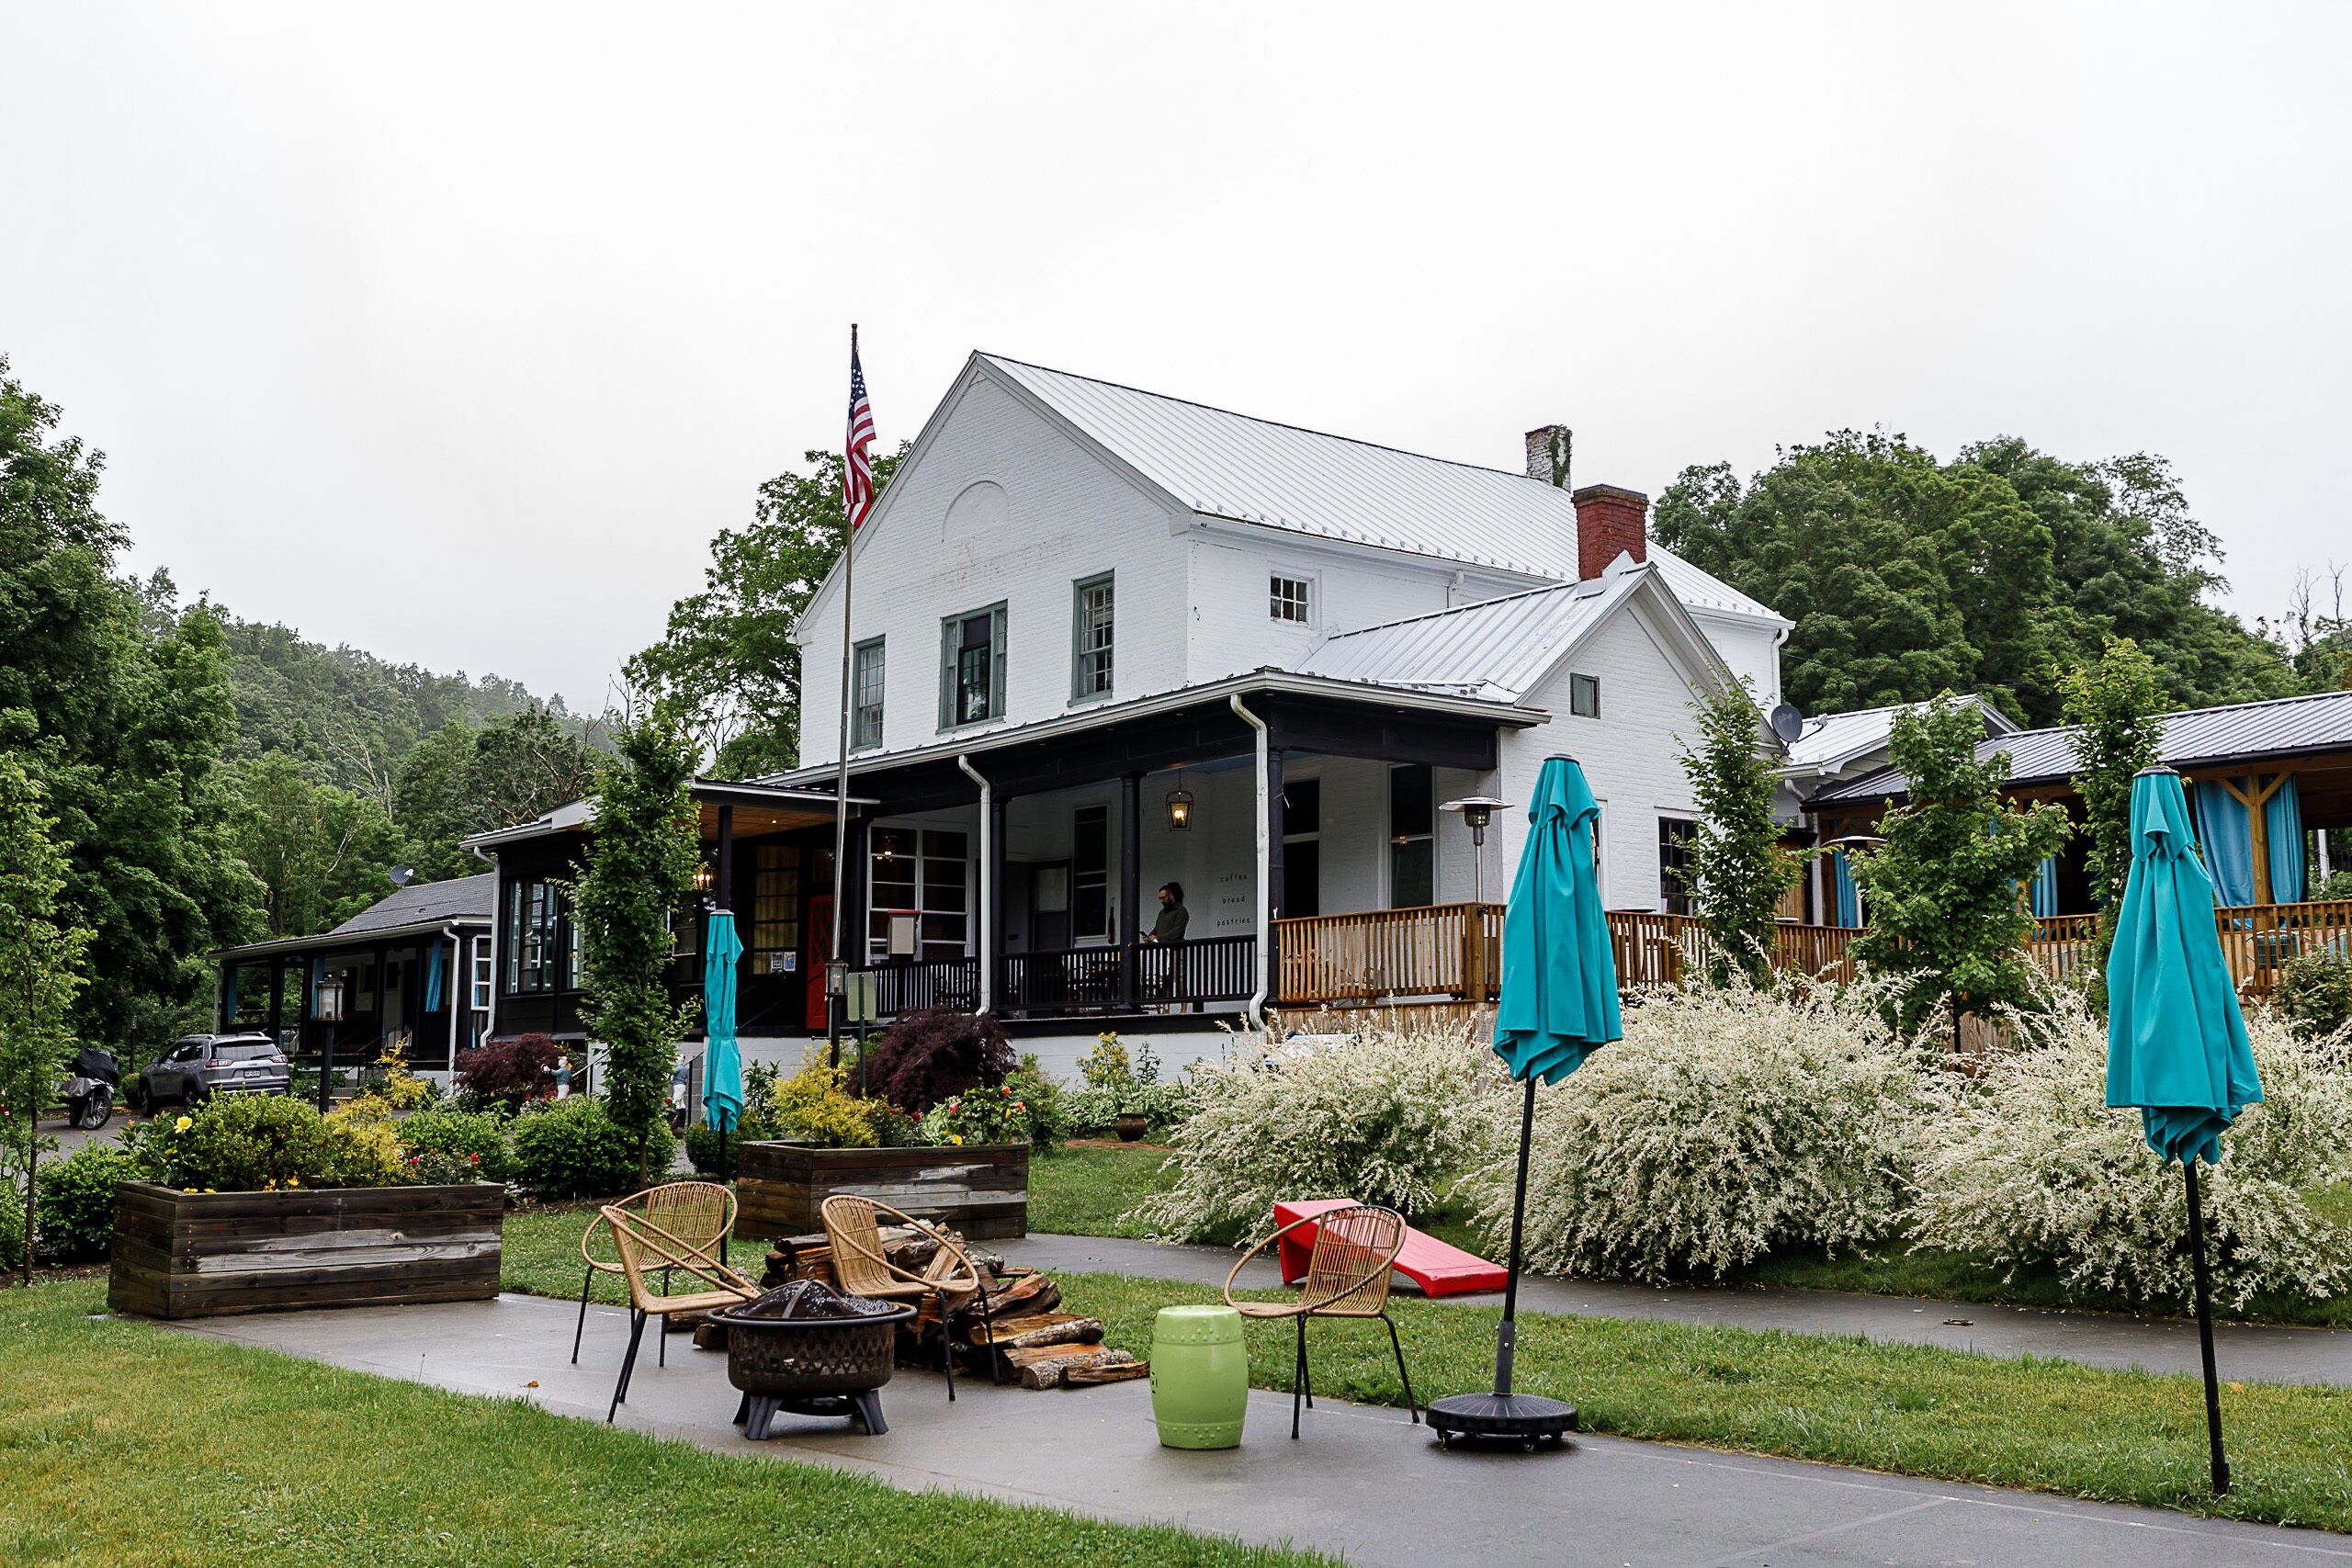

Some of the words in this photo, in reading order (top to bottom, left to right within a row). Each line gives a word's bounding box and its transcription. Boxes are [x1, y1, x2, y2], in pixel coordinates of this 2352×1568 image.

[1221, 874, 1247, 882] coffee
[1222, 896, 1245, 904] bread
[1217, 918, 1250, 928] pastries
